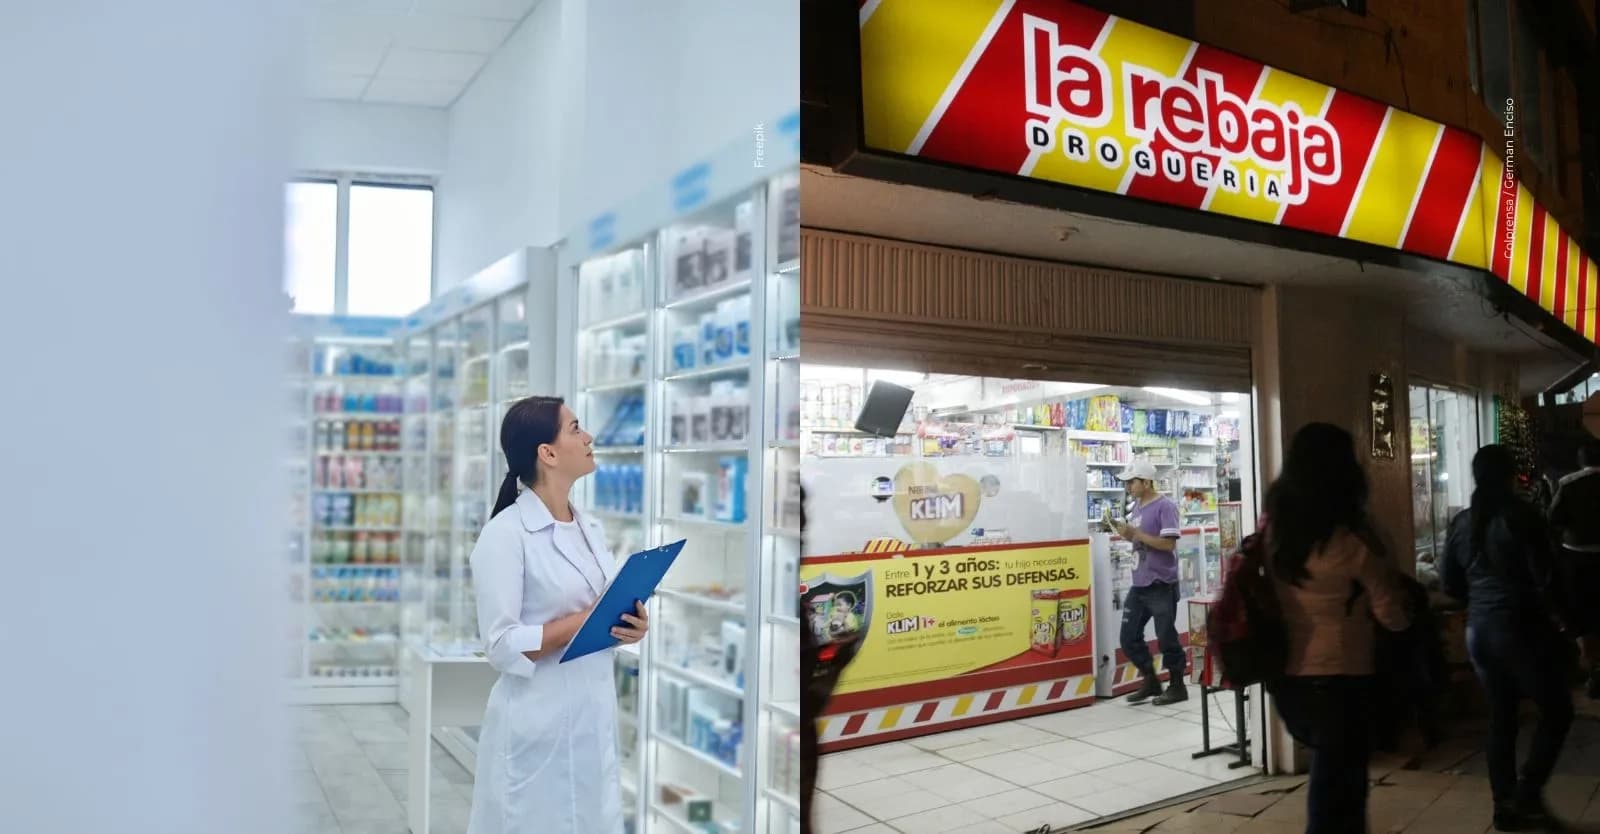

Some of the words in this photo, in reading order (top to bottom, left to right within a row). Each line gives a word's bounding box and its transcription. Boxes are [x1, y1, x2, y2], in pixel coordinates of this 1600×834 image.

[1029, 20, 1107, 123] la
[1126, 66, 1339, 200] rebaja
[1032, 125, 1281, 199] DROGUERIA
[910, 493, 964, 520] KLIM
[885, 570, 911, 580] Entre
[912, 562, 919, 577] 1
[924, 564, 935, 580] y
[939, 560, 950, 575] 3
[955, 557, 1000, 574] años:
[1005, 560, 1014, 569] tu
[1015, 559, 1031, 570] hijo
[1032, 556, 1068, 568] necesita
[885, 577, 969, 598] REFORZAR
[972, 574, 1001, 590] SUS
[1006, 567, 1080, 585] DEFENSAS.
[887, 616, 919, 634] KLIM
[922, 616, 936, 629] 1+
